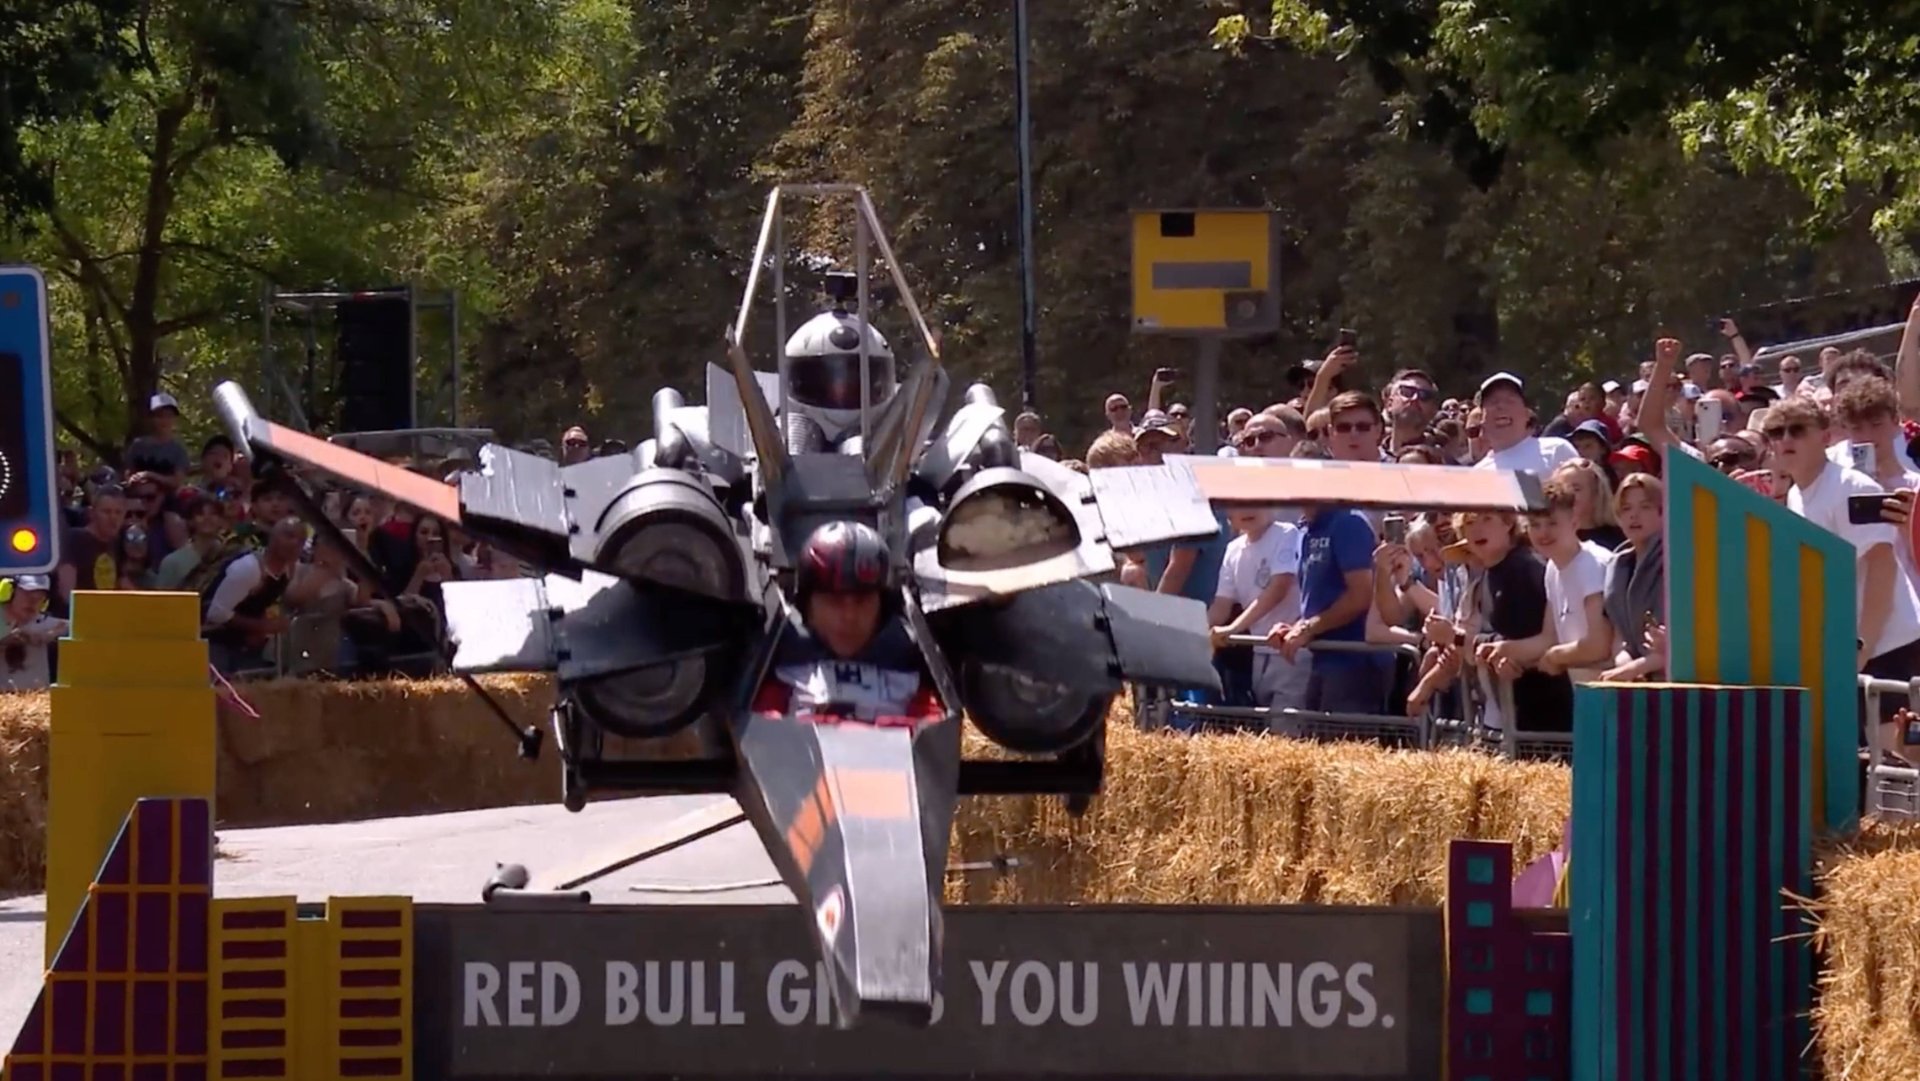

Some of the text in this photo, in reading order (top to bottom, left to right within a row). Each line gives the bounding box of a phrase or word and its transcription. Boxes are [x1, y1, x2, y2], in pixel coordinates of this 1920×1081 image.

[464, 961, 581, 1026] RED
[605, 961, 745, 1026] BULL
[969, 960, 1099, 1026] YOU
[1122, 962, 1395, 1028] WIIINGS.
